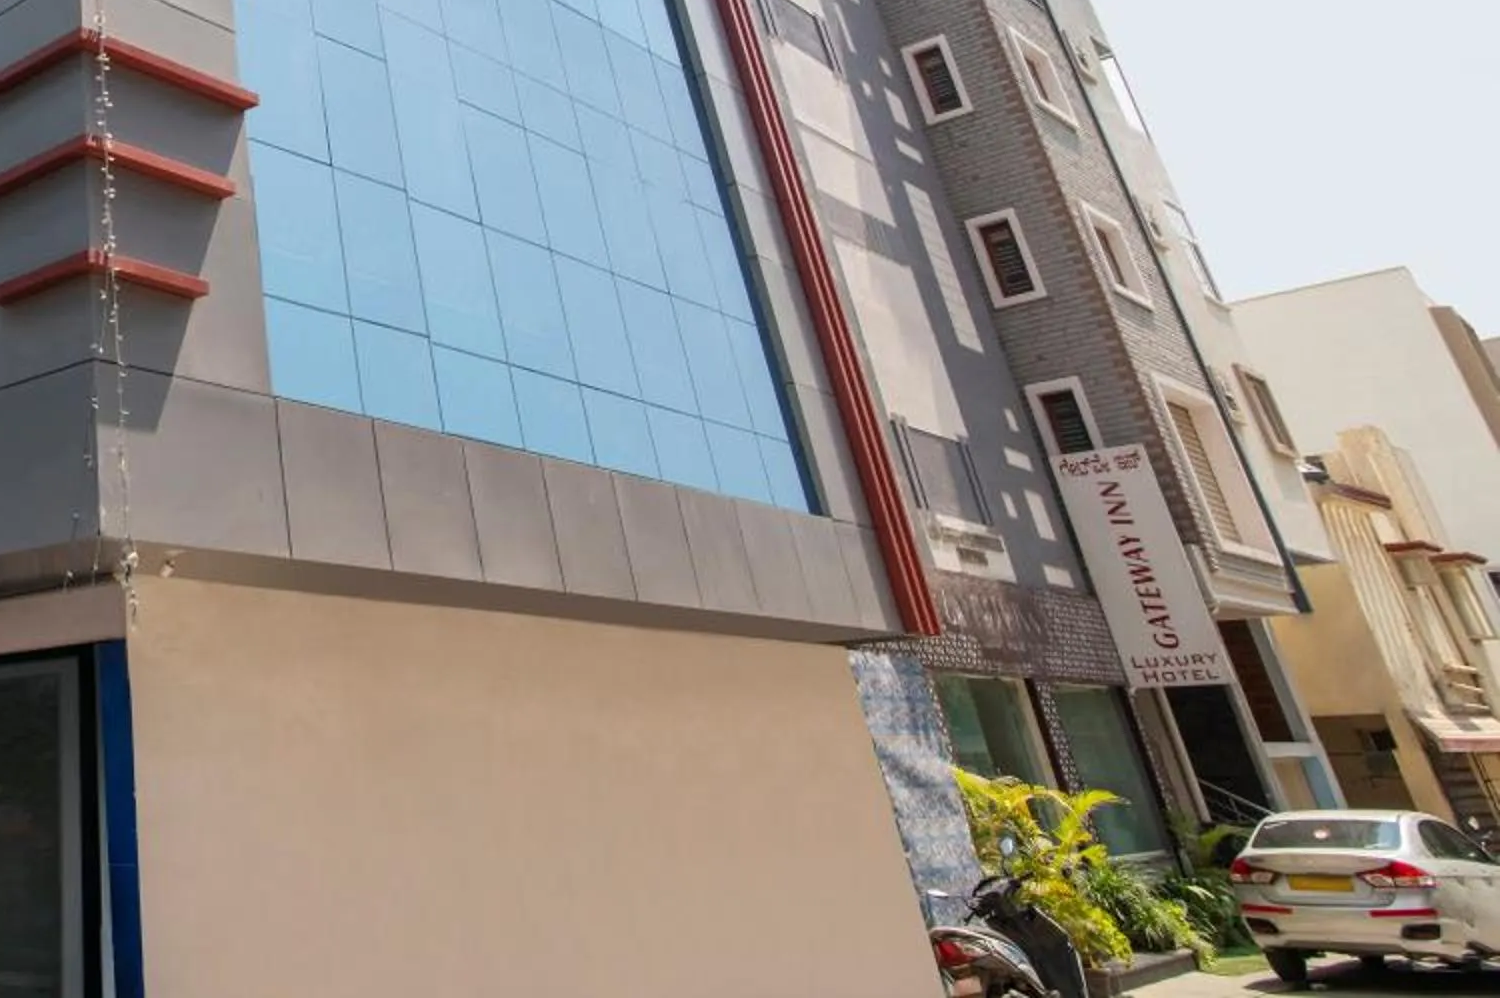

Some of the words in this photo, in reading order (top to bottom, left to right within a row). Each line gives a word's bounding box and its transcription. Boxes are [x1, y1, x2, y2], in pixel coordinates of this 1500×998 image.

[1097, 481, 1134, 524] INN
[1117, 535, 1180, 650] GATEWAY
[1131, 654, 1217, 669] LUXURY
[1142, 669, 1220, 683] HOTEL
